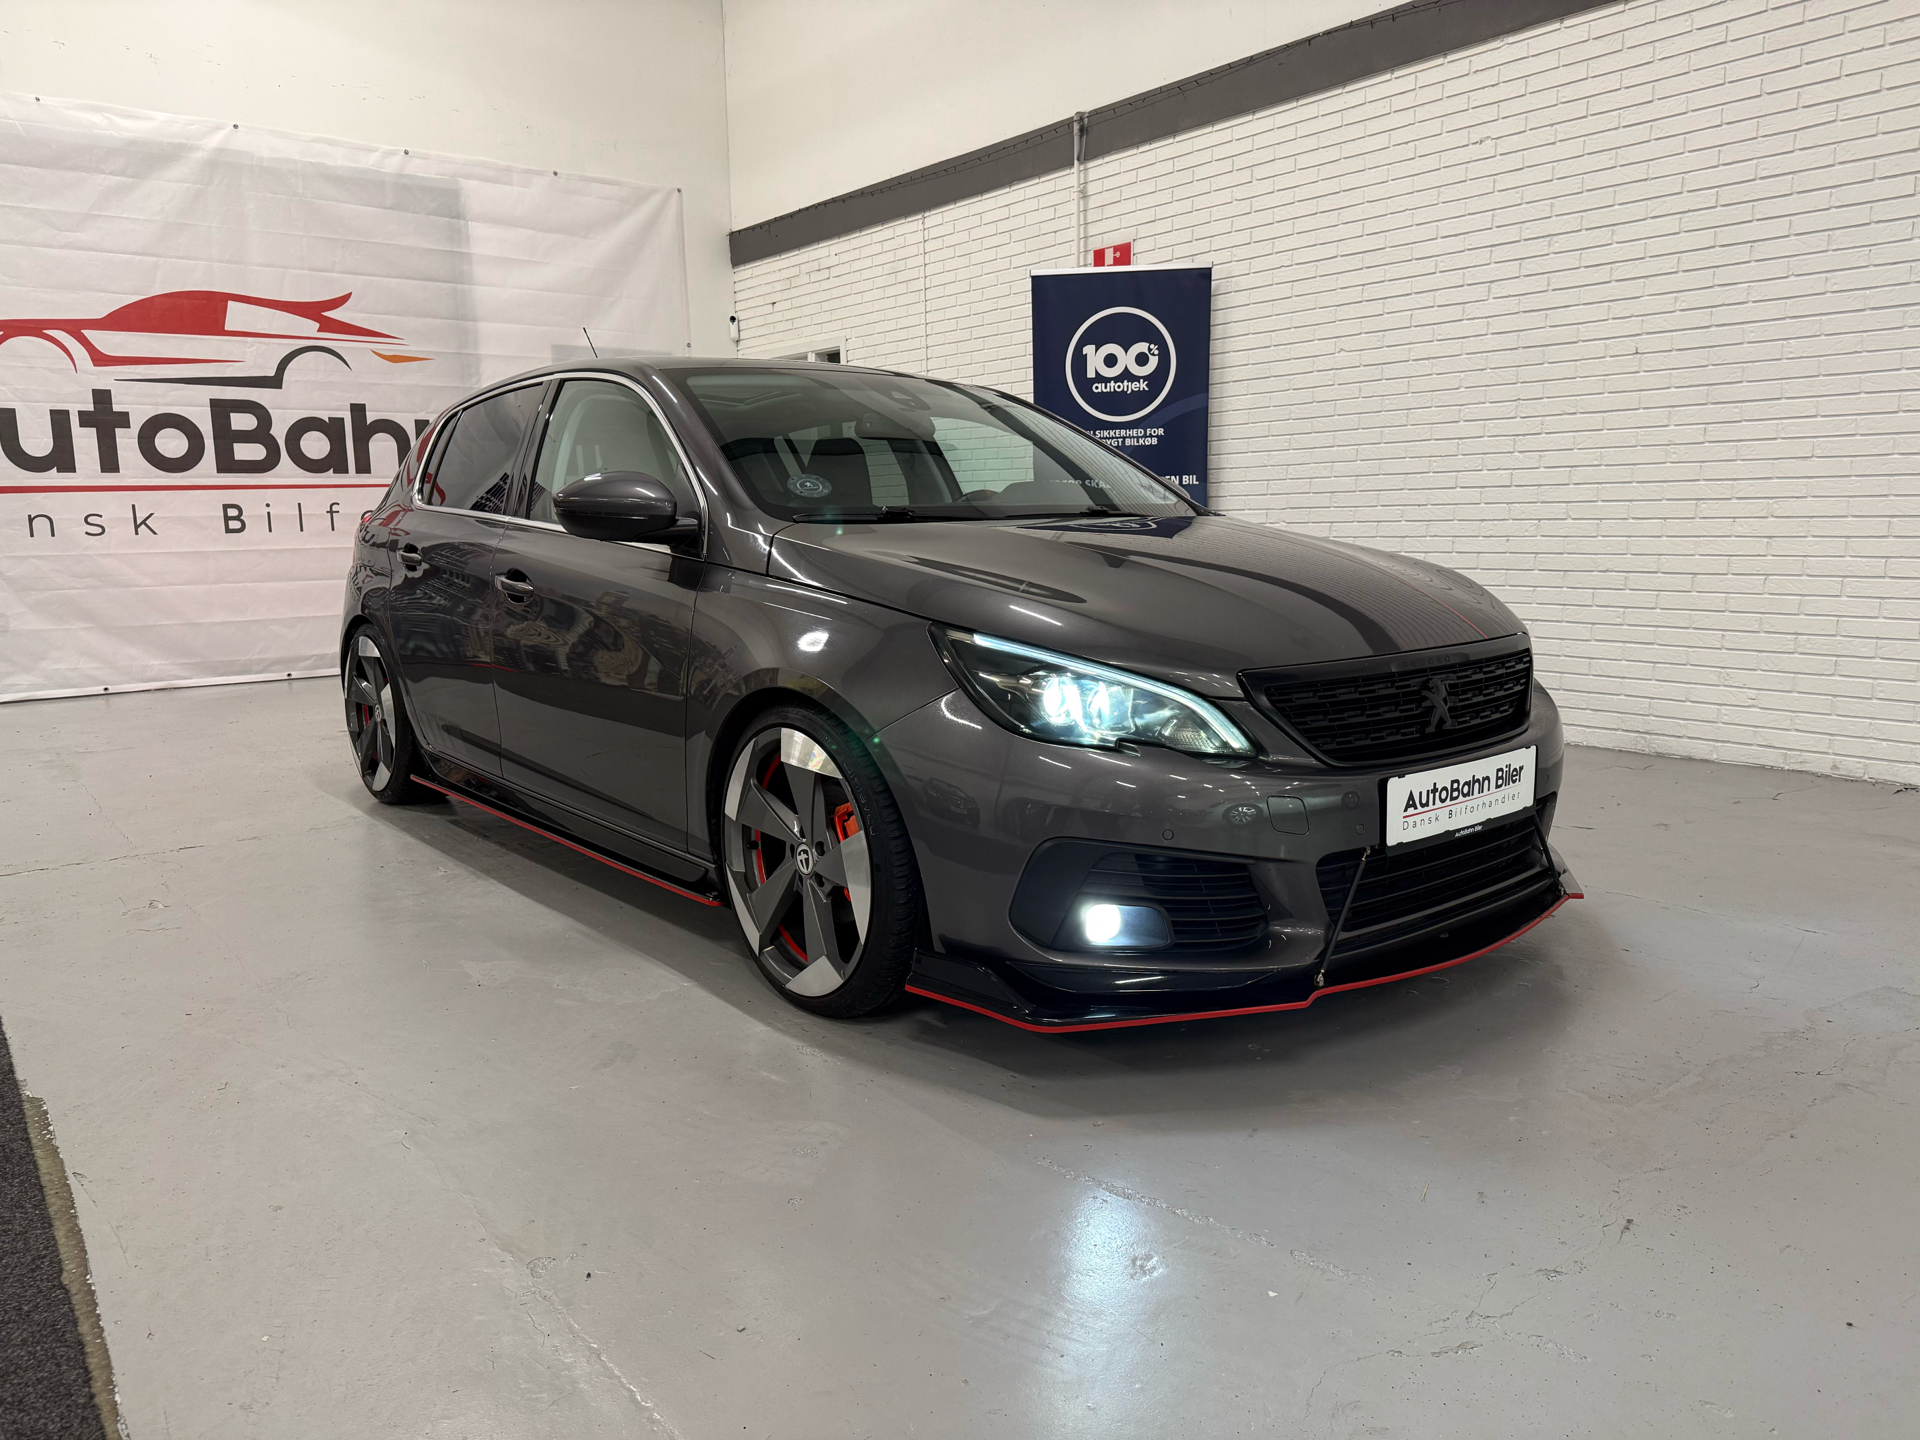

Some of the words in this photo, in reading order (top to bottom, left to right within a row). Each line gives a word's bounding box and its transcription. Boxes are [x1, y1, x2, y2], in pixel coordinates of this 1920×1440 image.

[1092, 378, 1149, 394] autotjek
[0, 388, 430, 474] utoBah
[1095, 429, 1144, 438] SIKKERHED
[1146, 427, 1165, 437] FOR
[1125, 437, 1158, 446] BILKØB
[1182, 474, 1200, 485] BIL
[1403, 774, 1491, 813] AutoBahn
[1495, 763, 1524, 790] Biler
[1402, 813, 1440, 831] Dansk
[1448, 791, 1521, 819] Bilforhandler
